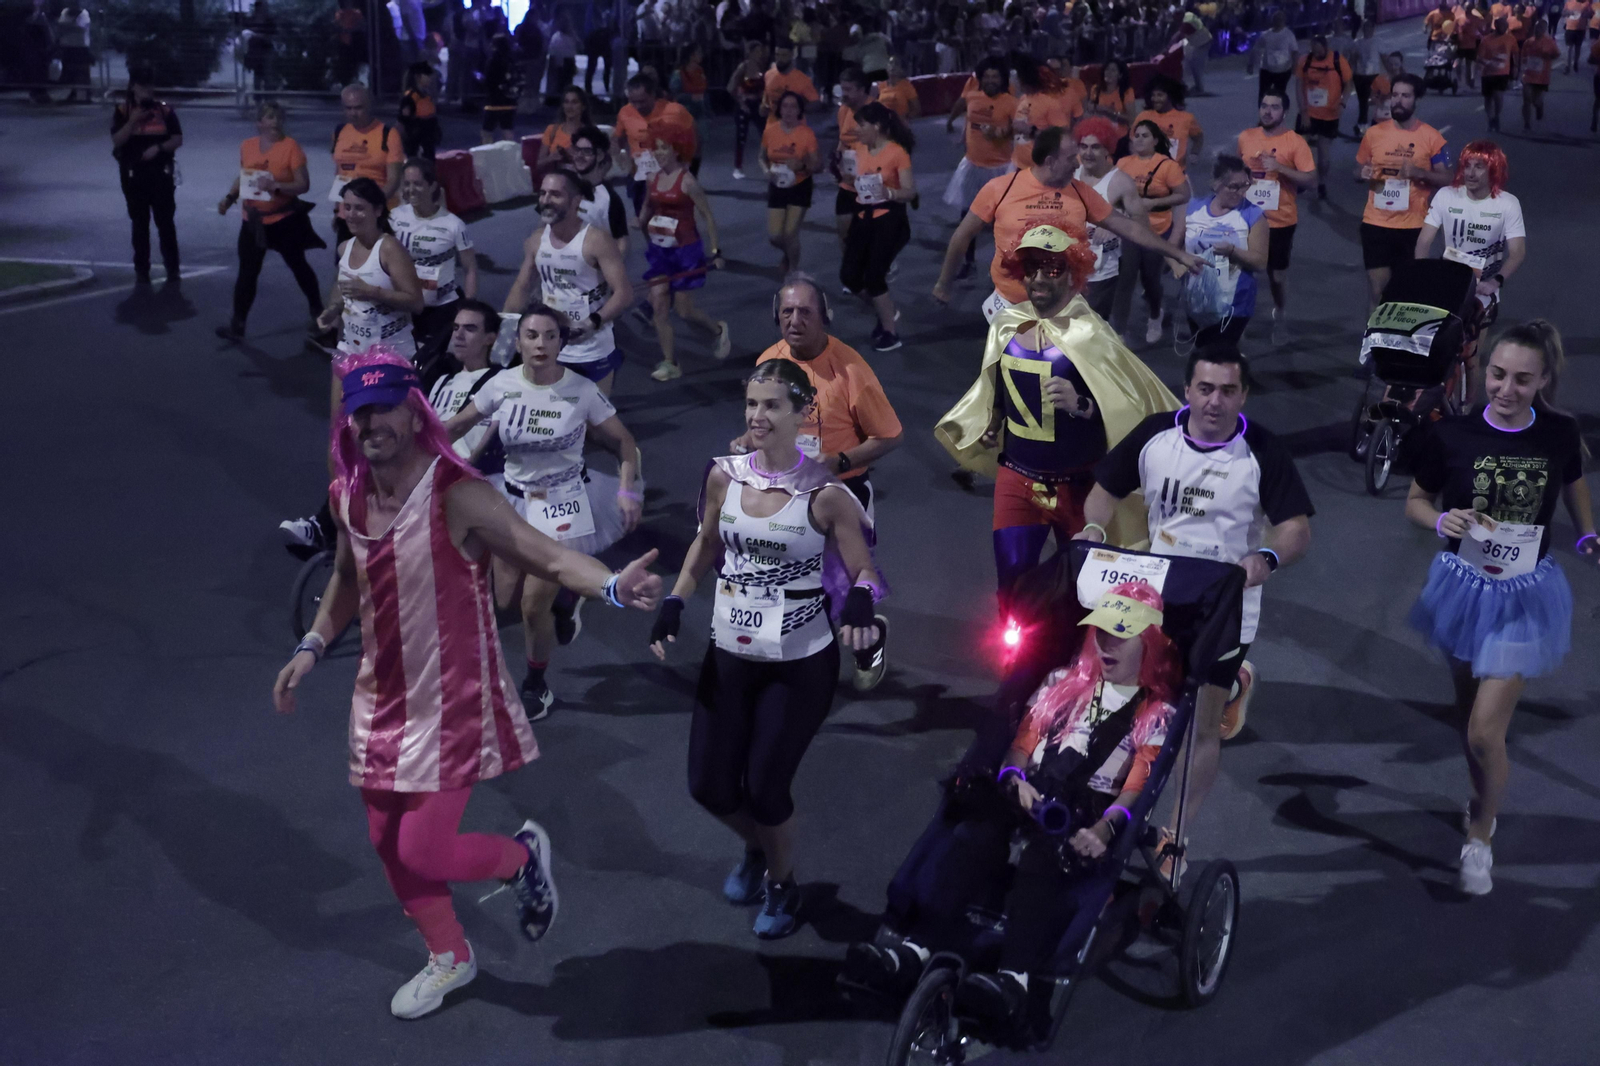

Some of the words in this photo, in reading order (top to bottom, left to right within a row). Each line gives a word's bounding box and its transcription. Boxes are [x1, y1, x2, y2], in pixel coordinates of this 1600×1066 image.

[1468, 222, 1492, 232] CARROS
[1400, 306, 1429, 314] CARROS
[530, 408, 562, 419] CARROS
[528, 418, 539, 426] DE
[526, 426, 554, 436] FUEGO
[1184, 486, 1215, 500] CARROS
[1182, 496, 1193, 506] DE
[542, 500, 580, 519] 12520
[746, 537, 787, 552] CARROS
[748, 546, 760, 554] DE
[1482, 540, 1520, 561] 3679
[749, 554, 780, 566] FUEGO
[730, 607, 762, 628] 9320
